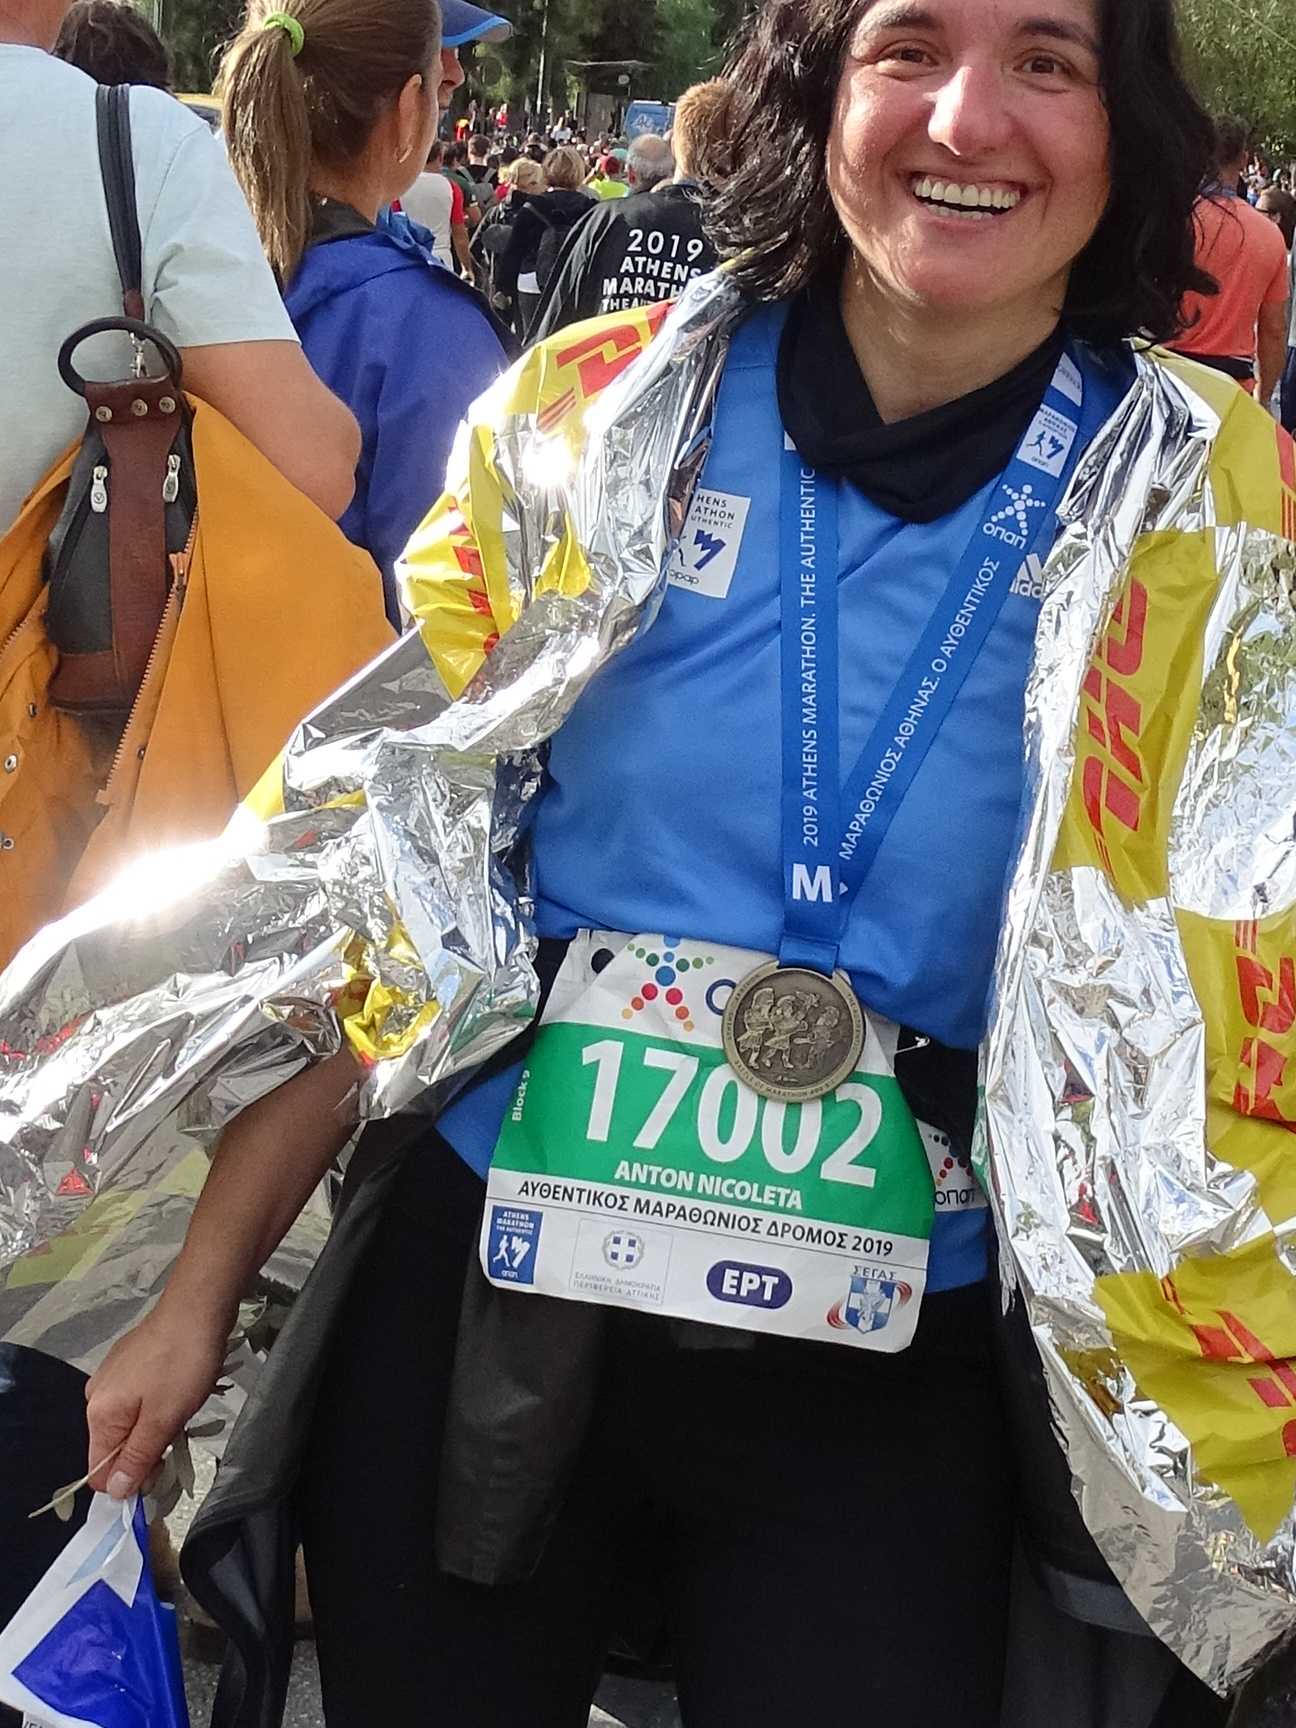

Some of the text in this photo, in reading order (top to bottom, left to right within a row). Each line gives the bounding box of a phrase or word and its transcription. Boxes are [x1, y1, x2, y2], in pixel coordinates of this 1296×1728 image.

[626, 228, 704, 262] 2019
[602, 277, 685, 299] MARATH
[694, 506, 736, 521] ATHON
[697, 494, 728, 508] HENS
[690, 515, 734, 530] UTHENTIC
[800, 573, 816, 608] THE
[800, 613, 817, 725] MARATHON.
[838, 747, 902, 860] ΜΑΡΑΘΩΝΙΟΣ
[940, 555, 1001, 659] ΑΥΘΕΝΤΙΚΟΣ
[802, 729, 817, 800] ATHENS
[802, 807, 818, 846] 2019
[512, 1081, 528, 1121] Block
[581, 1038, 883, 1188] 17002
[614, 1159, 803, 1211] ANTON NICOLETA
[517, 1179, 894, 1257] ΑΥΘΕΝΤΙΚΟΣ ΜΑΡΑΘΩΝΙΟΣ ΔΡΟΜΟΣ 2019
[853, 1264, 897, 1281] ΣΕΓΑΣ
